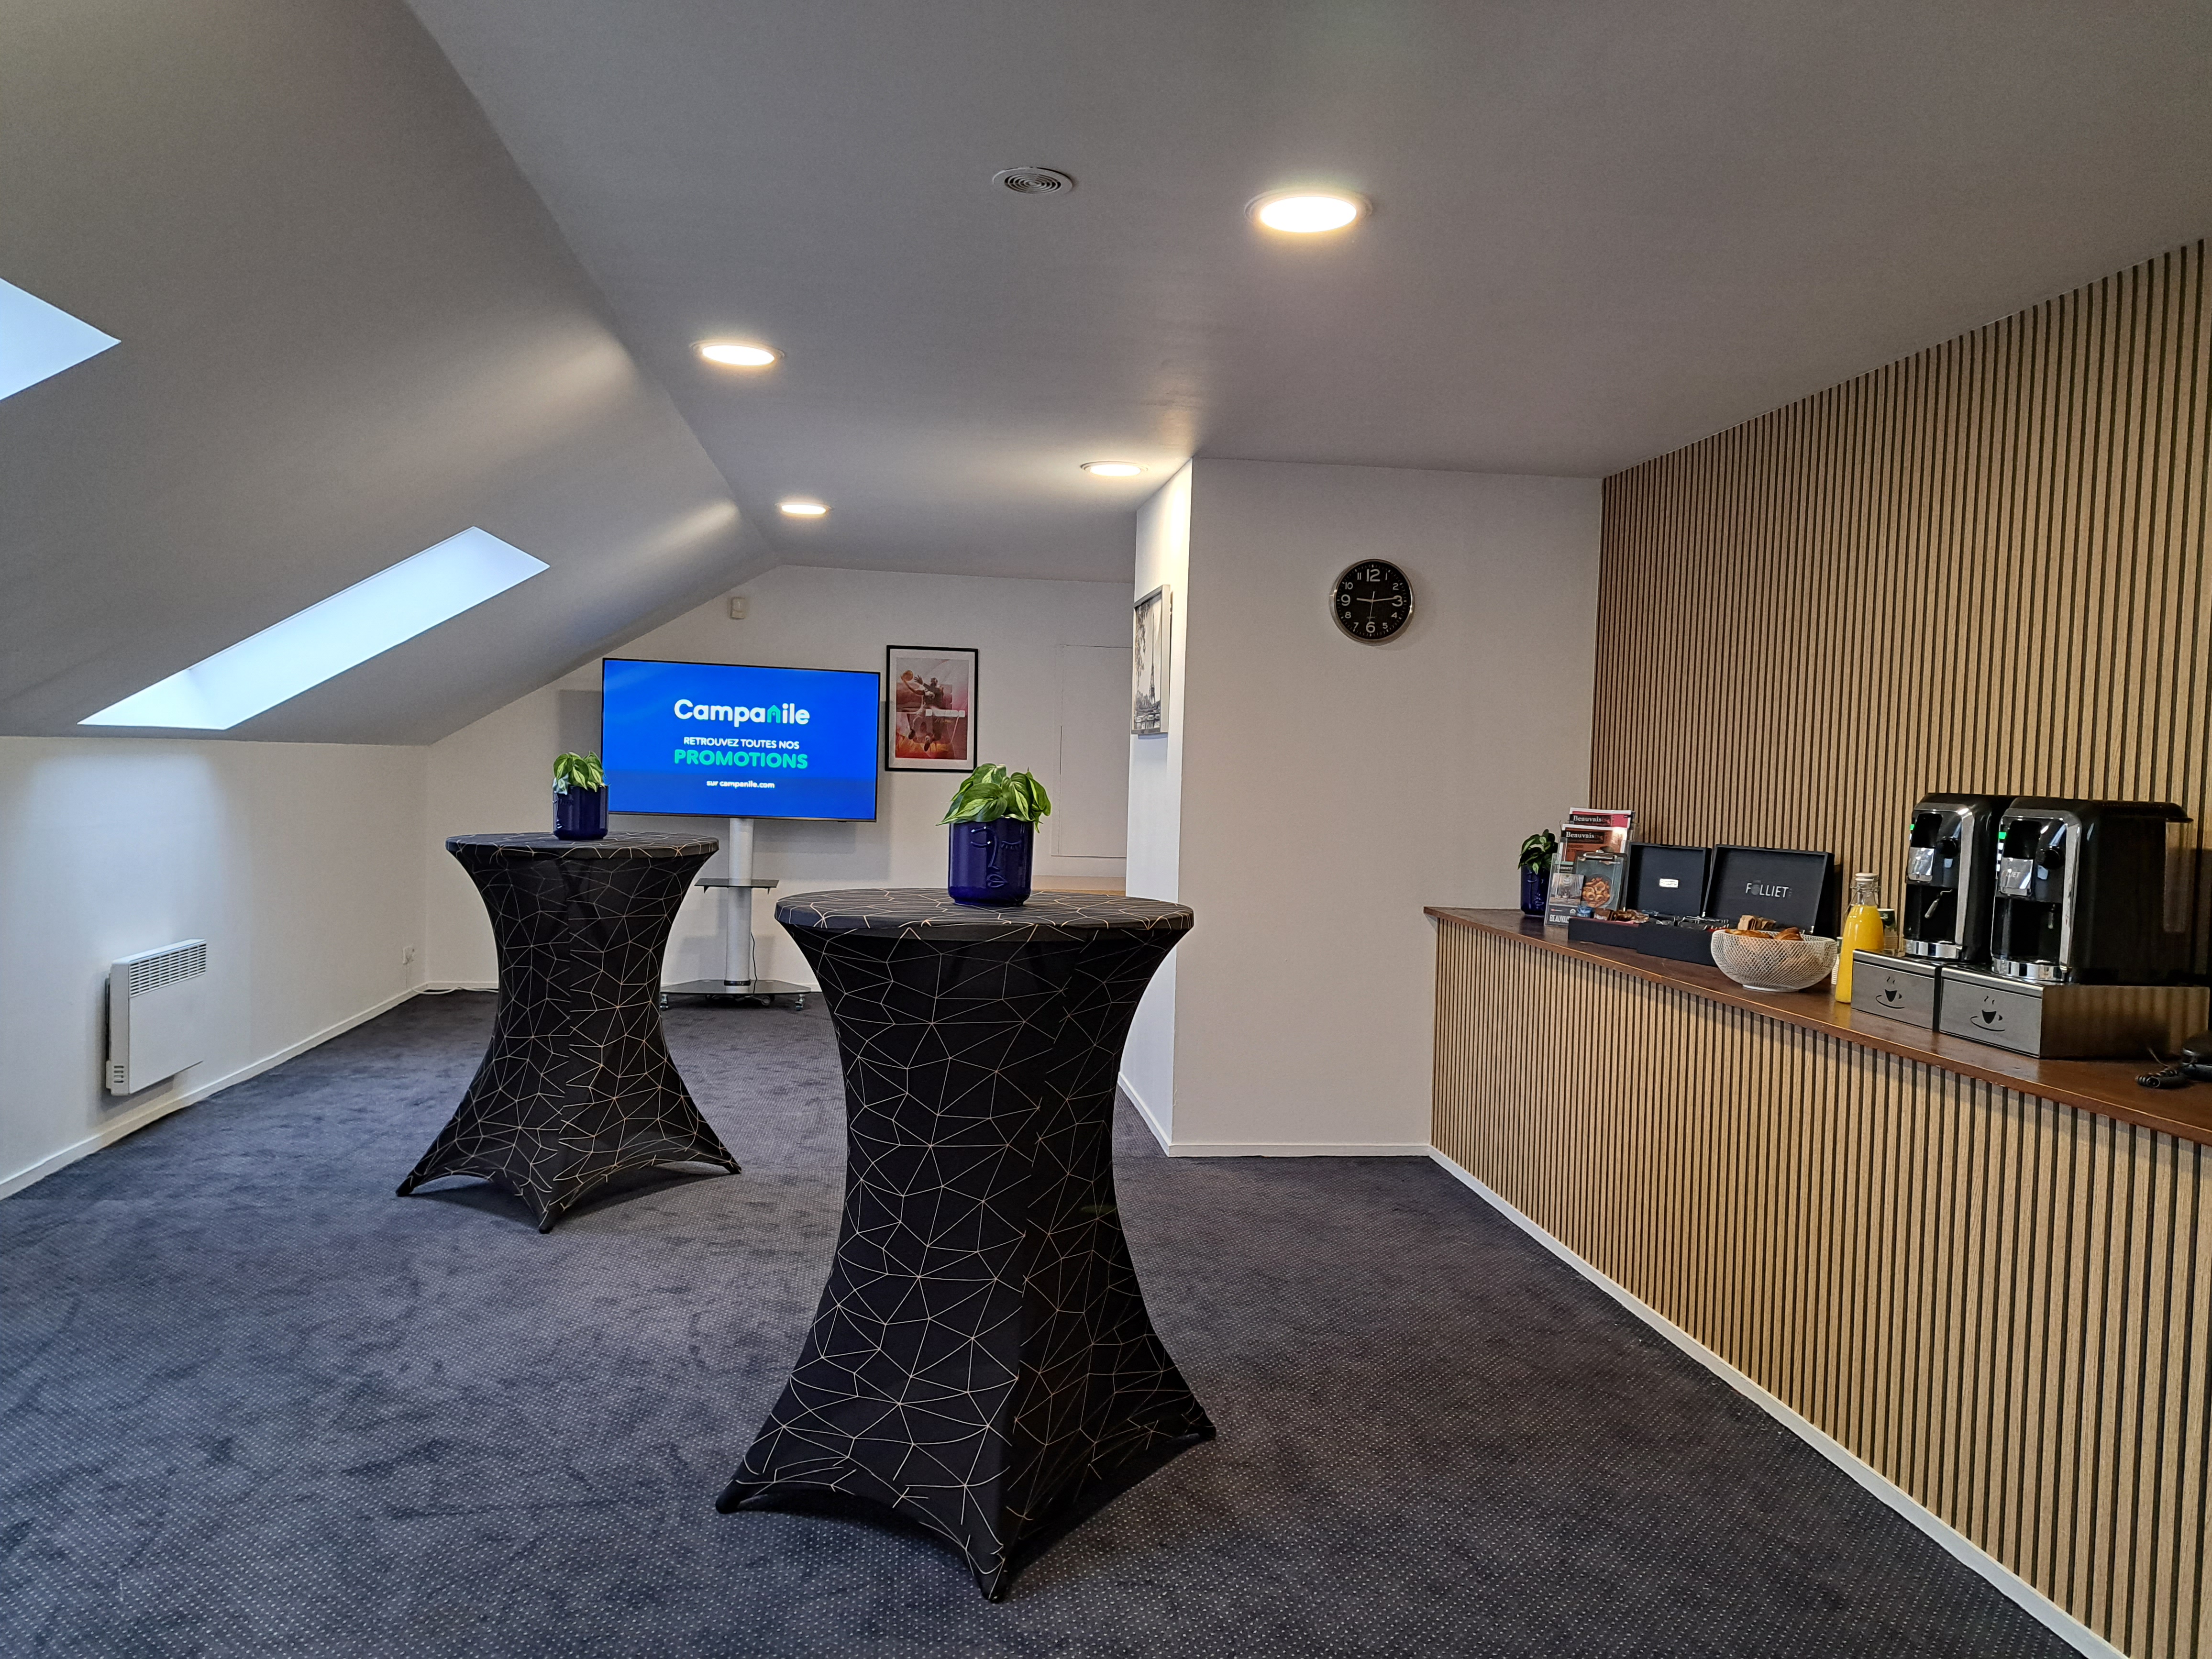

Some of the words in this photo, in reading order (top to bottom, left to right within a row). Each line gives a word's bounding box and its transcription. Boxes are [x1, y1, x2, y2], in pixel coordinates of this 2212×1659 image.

[1357, 572, 1361, 580] 11
[1366, 569, 1380, 582] 12
[1345, 582, 1353, 590] 10
[1341, 594, 1350, 606] 9
[1392, 595, 1403, 607] 3
[1366, 621, 1375, 633] 6
[674, 699, 810, 727] Campanile
[684, 737, 739, 747] RETROUVEZ
[741, 738, 776, 748] TOUTES
[779, 741, 799, 749] NOS
[675, 749, 808, 769] PROMOTIONS
[719, 781, 775, 789] campanile.com
